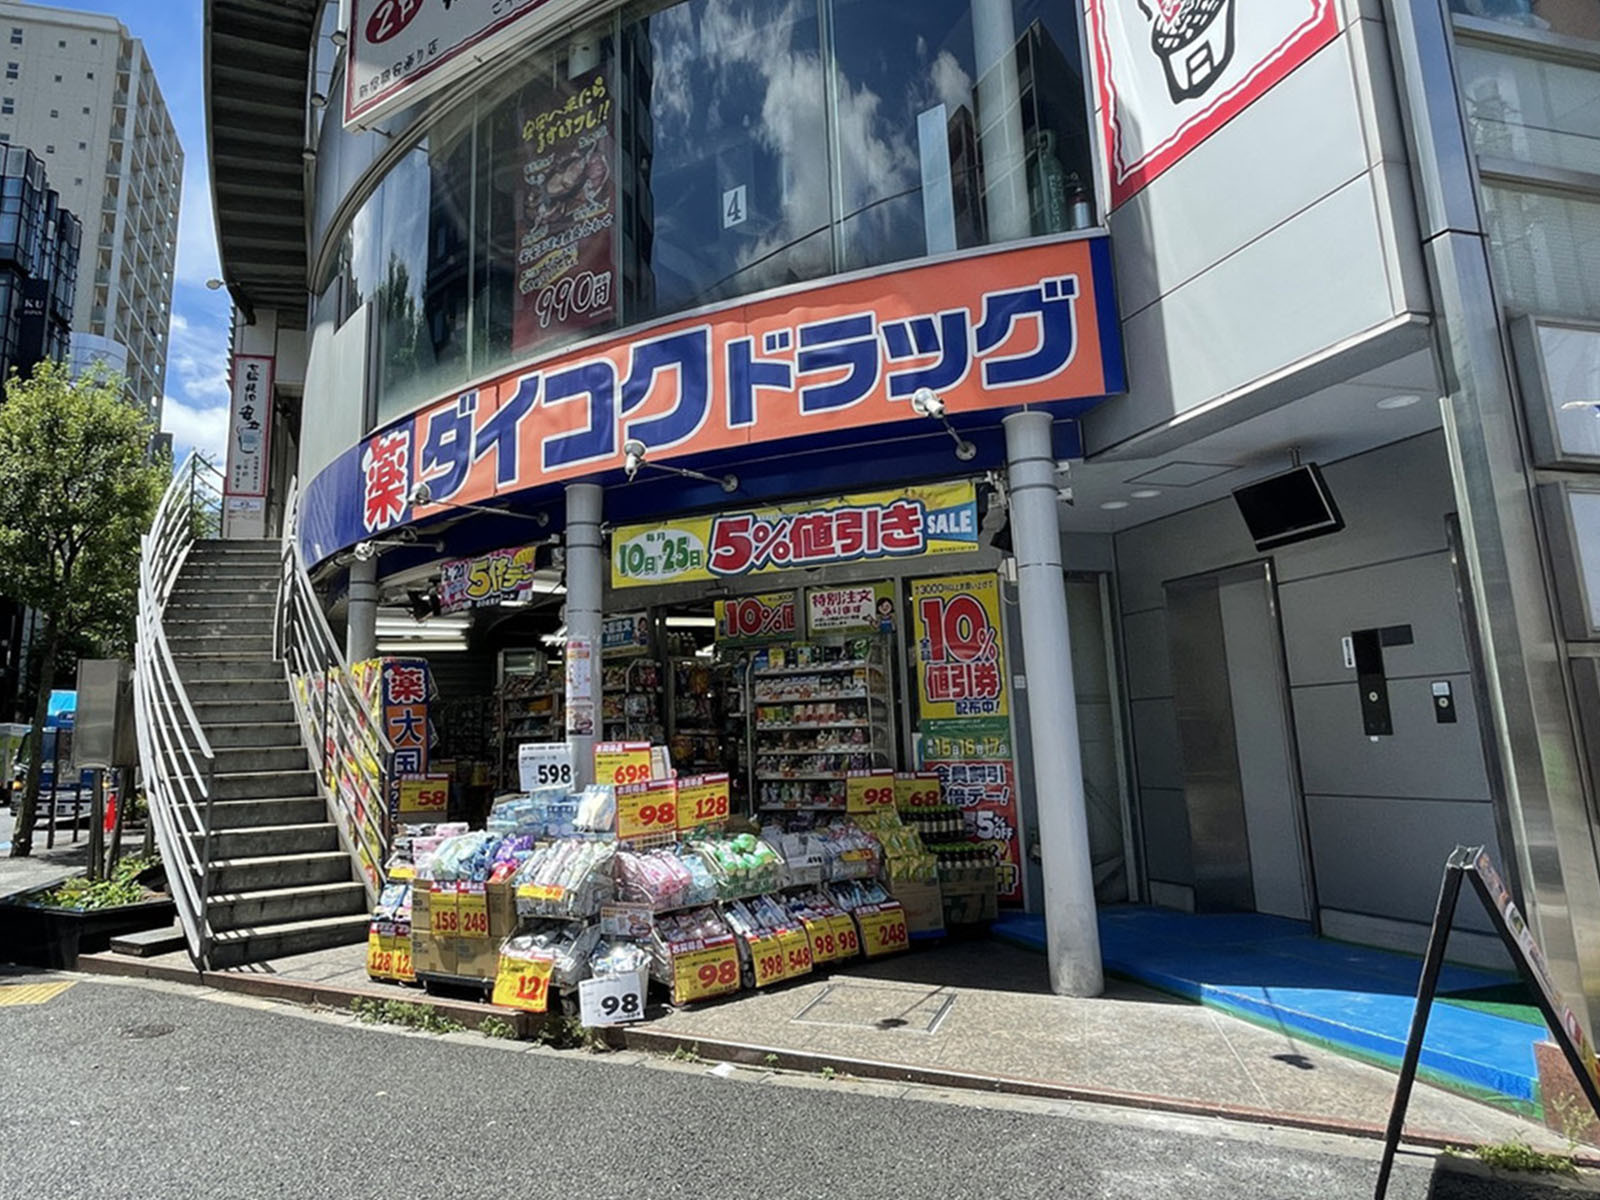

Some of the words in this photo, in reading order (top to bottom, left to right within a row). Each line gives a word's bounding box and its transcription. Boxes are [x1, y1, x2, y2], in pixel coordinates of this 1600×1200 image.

[727, 190, 742, 222] 4
[363, 430, 412, 532] 薬
[420, 274, 1079, 505] ダイコクドラッグ
[926, 509, 973, 535] SALE
[709, 499, 925, 575] 5%値引き
[811, 589, 872, 608] 特別注文
[921, 595, 998, 662] 10%
[926, 662, 1000, 700] 値引券
[537, 763, 572, 785] 598
[614, 764, 650, 784] 698
[418, 790, 446, 806] 58
[863, 788, 893, 805] 98
[910, 790, 939, 807] 68
[940, 785, 1009, 807] 倍デー!
[639, 802, 676, 826] 98
[695, 795, 728, 820] 128
[434, 910, 459, 932] 158
[463, 911, 488, 933] 248
[815, 934, 835, 955] 98
[838, 930, 857, 950] 98
[879, 923, 906, 947] 248
[370, 950, 392, 972] 128
[697, 960, 737, 989] 98
[601, 993, 639, 1016] 98
